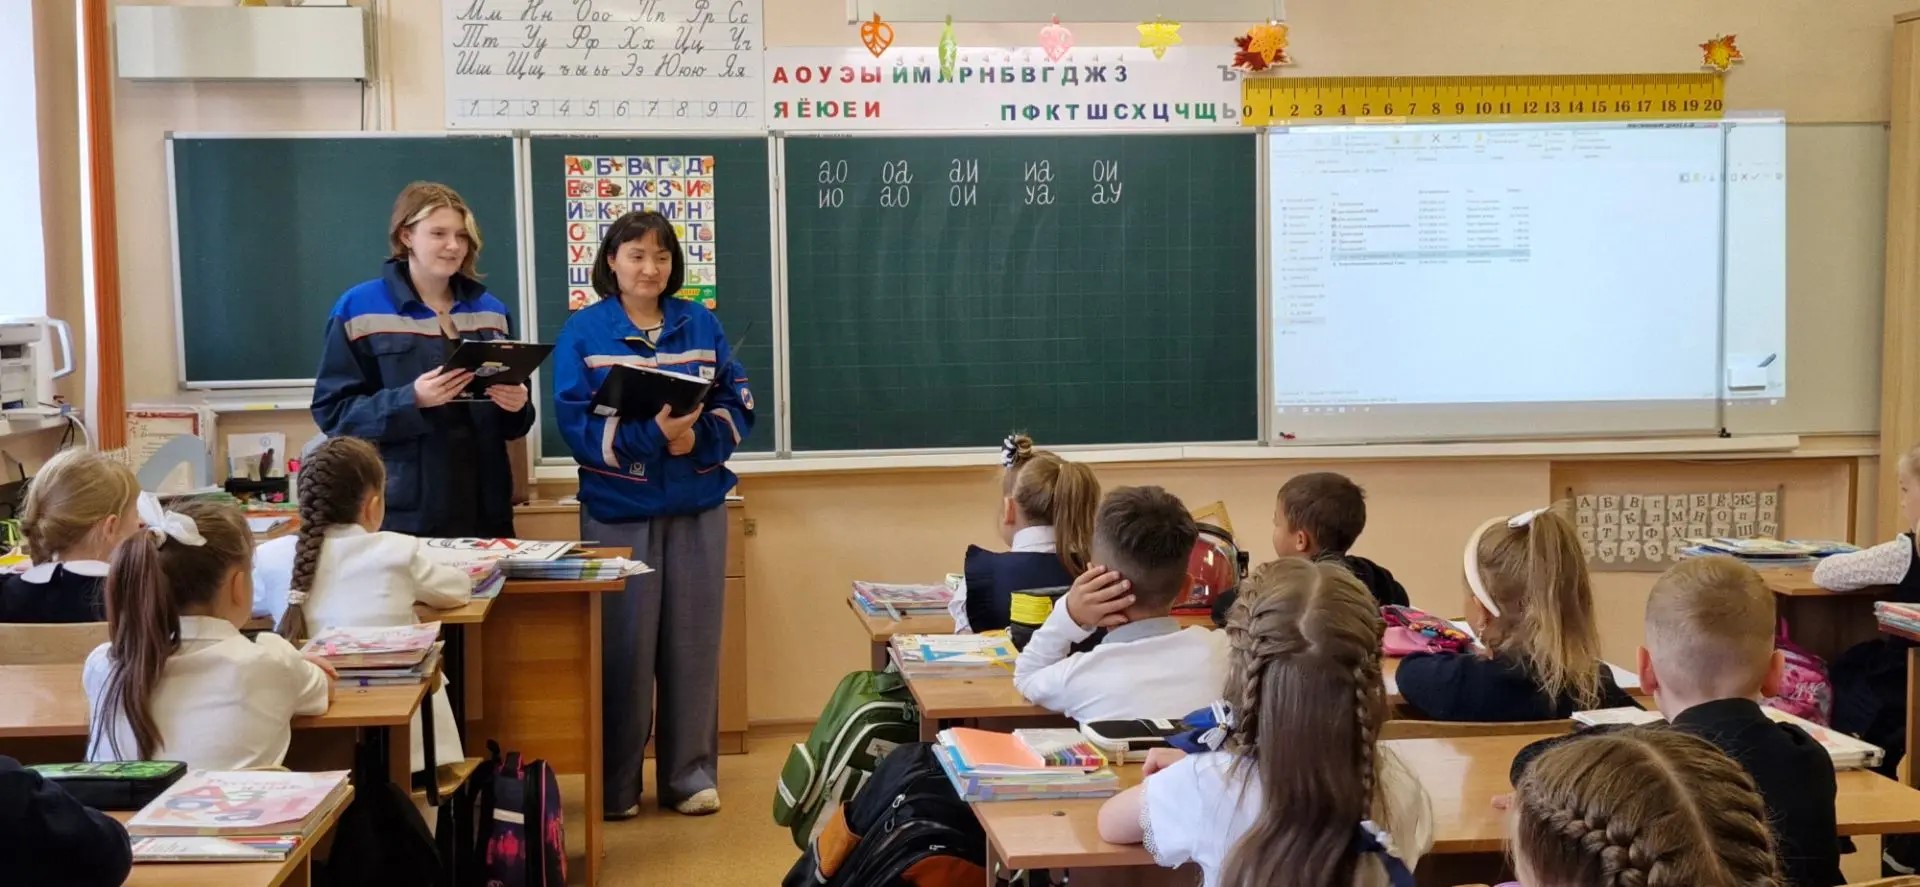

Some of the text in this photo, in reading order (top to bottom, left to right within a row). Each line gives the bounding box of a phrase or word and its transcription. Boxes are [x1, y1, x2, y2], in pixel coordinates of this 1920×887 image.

[456, 0, 502, 21] Мм
[520, 0, 553, 21] Нн
[630, 0, 666, 22] Пп
[686, 0, 715, 32] Рр
[728, 0, 748, 24] Сс
[453, 23, 752, 60] Тт Уу Фф Хх Цц Чч
[456, 50, 492, 76] Шш
[505, 50, 546, 80] Щщ
[621, 52, 644, 77] Ээ
[719, 53, 745, 78] Яя
[1217, 65, 1237, 81] Ъ
[470, 100, 748, 117] 1 2 3 4 5 6 7 8 9 0
[1243, 100, 1722, 117] 0 1 2 3 4 5 6 7 8 9 10 11 12 13 14 15 16 17 18 19 20
[568, 158, 703, 175] А Б В Г Д
[568, 178, 701, 197] Е Ё Ж З И
[568, 200, 583, 219] Й
[599, 202, 611, 219] К
[659, 202, 675, 219] М
[688, 202, 701, 219] Н
[569, 223, 585, 241] О
[688, 224, 701, 240] Т
[570, 245, 703, 262] У Ч
[570, 268, 588, 284] Ш
[1580, 497, 1590, 508] А
[1604, 497, 1612, 508] Б
[1630, 497, 1639, 508] В
[1697, 496, 1705, 507] Е
[1735, 495, 1751, 505] Ж
[1765, 495, 1773, 506] З
[1672, 512, 1683, 521] М
[1646, 528, 1658, 538] Ф
